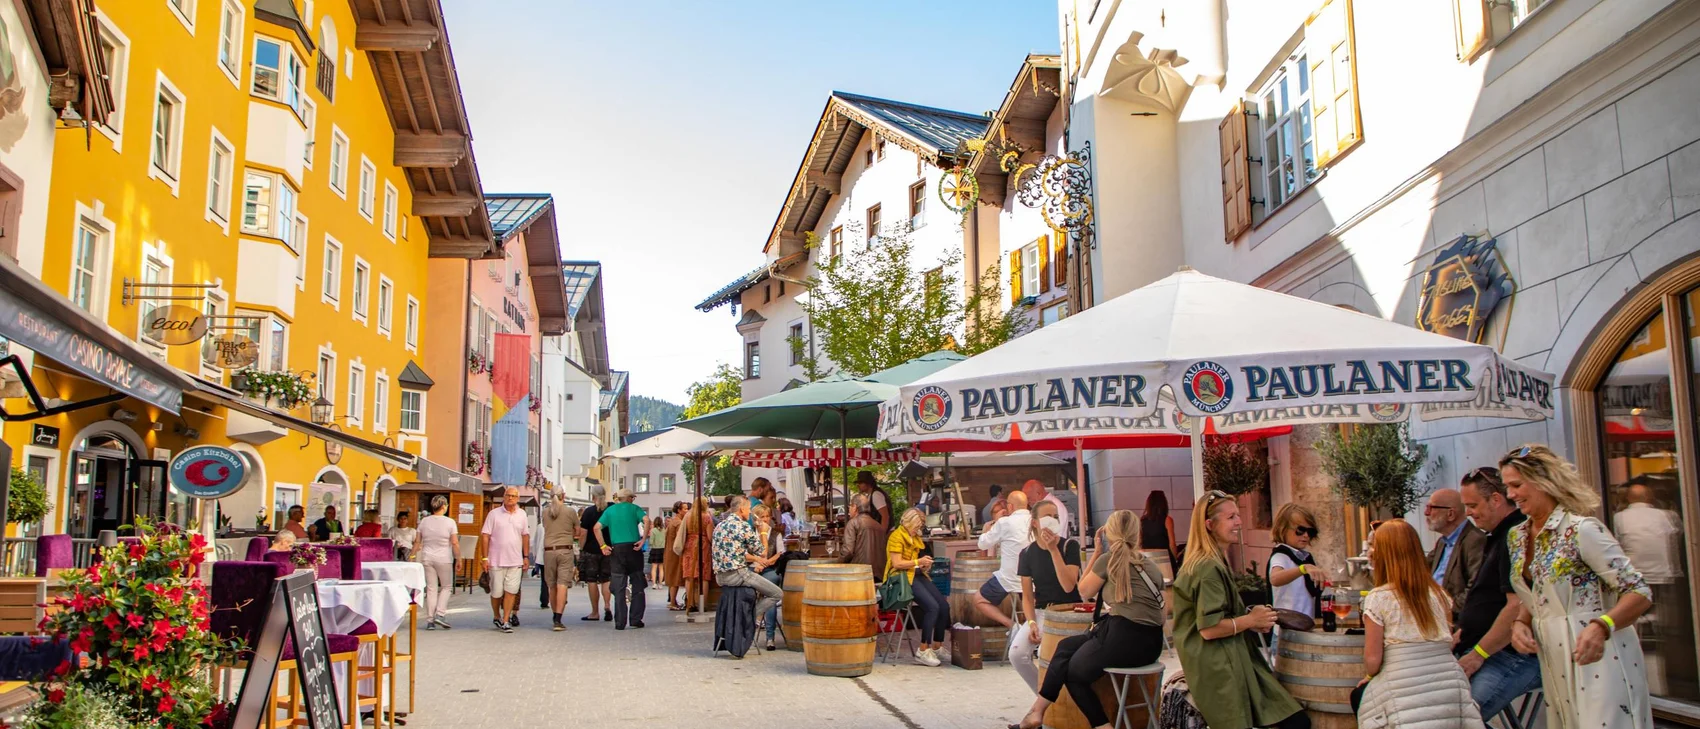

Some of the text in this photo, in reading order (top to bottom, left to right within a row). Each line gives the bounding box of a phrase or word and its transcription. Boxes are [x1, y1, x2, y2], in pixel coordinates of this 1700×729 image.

[151, 316, 199, 331] ecco!
[69, 334, 104, 374] CASINO
[1183, 361, 1230, 385] PAULANER
[1240, 359, 1477, 403] PAULANER
[912, 386, 951, 408] PAULANER
[958, 374, 1148, 423] PAULANER
[1191, 395, 1230, 413] MÜNCHEN
[916, 414, 949, 431] MÜNCHEN
[174, 449, 242, 470] Casino Kitzbühel
